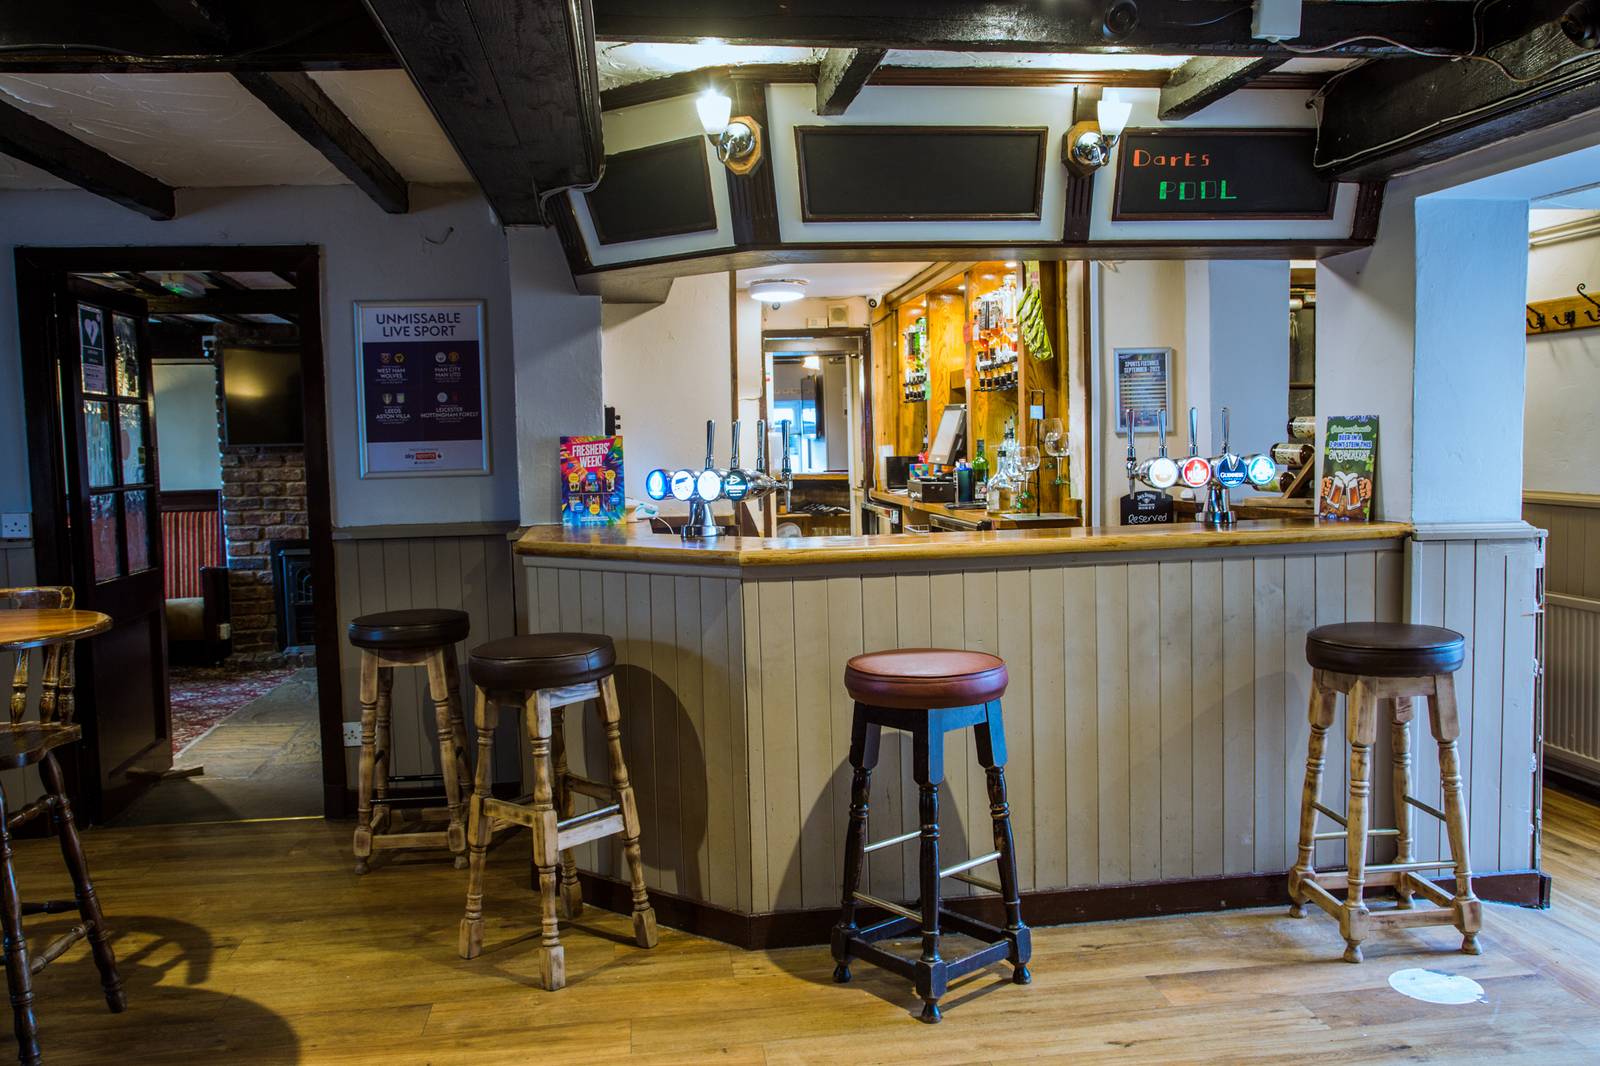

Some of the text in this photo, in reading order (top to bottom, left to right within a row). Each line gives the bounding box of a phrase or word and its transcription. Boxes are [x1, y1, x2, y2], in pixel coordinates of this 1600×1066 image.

[1133, 149, 1210, 167] Darts
[1159, 180, 1237, 200] POOL
[376, 313, 461, 324] UNMISSABLE
[382, 325, 456, 337] LIVE SPORT
[579, 455, 602, 468] WEEK!
[1220, 471, 1244, 479] GUINNESS
[1128, 513, 1168, 525] Reserved
